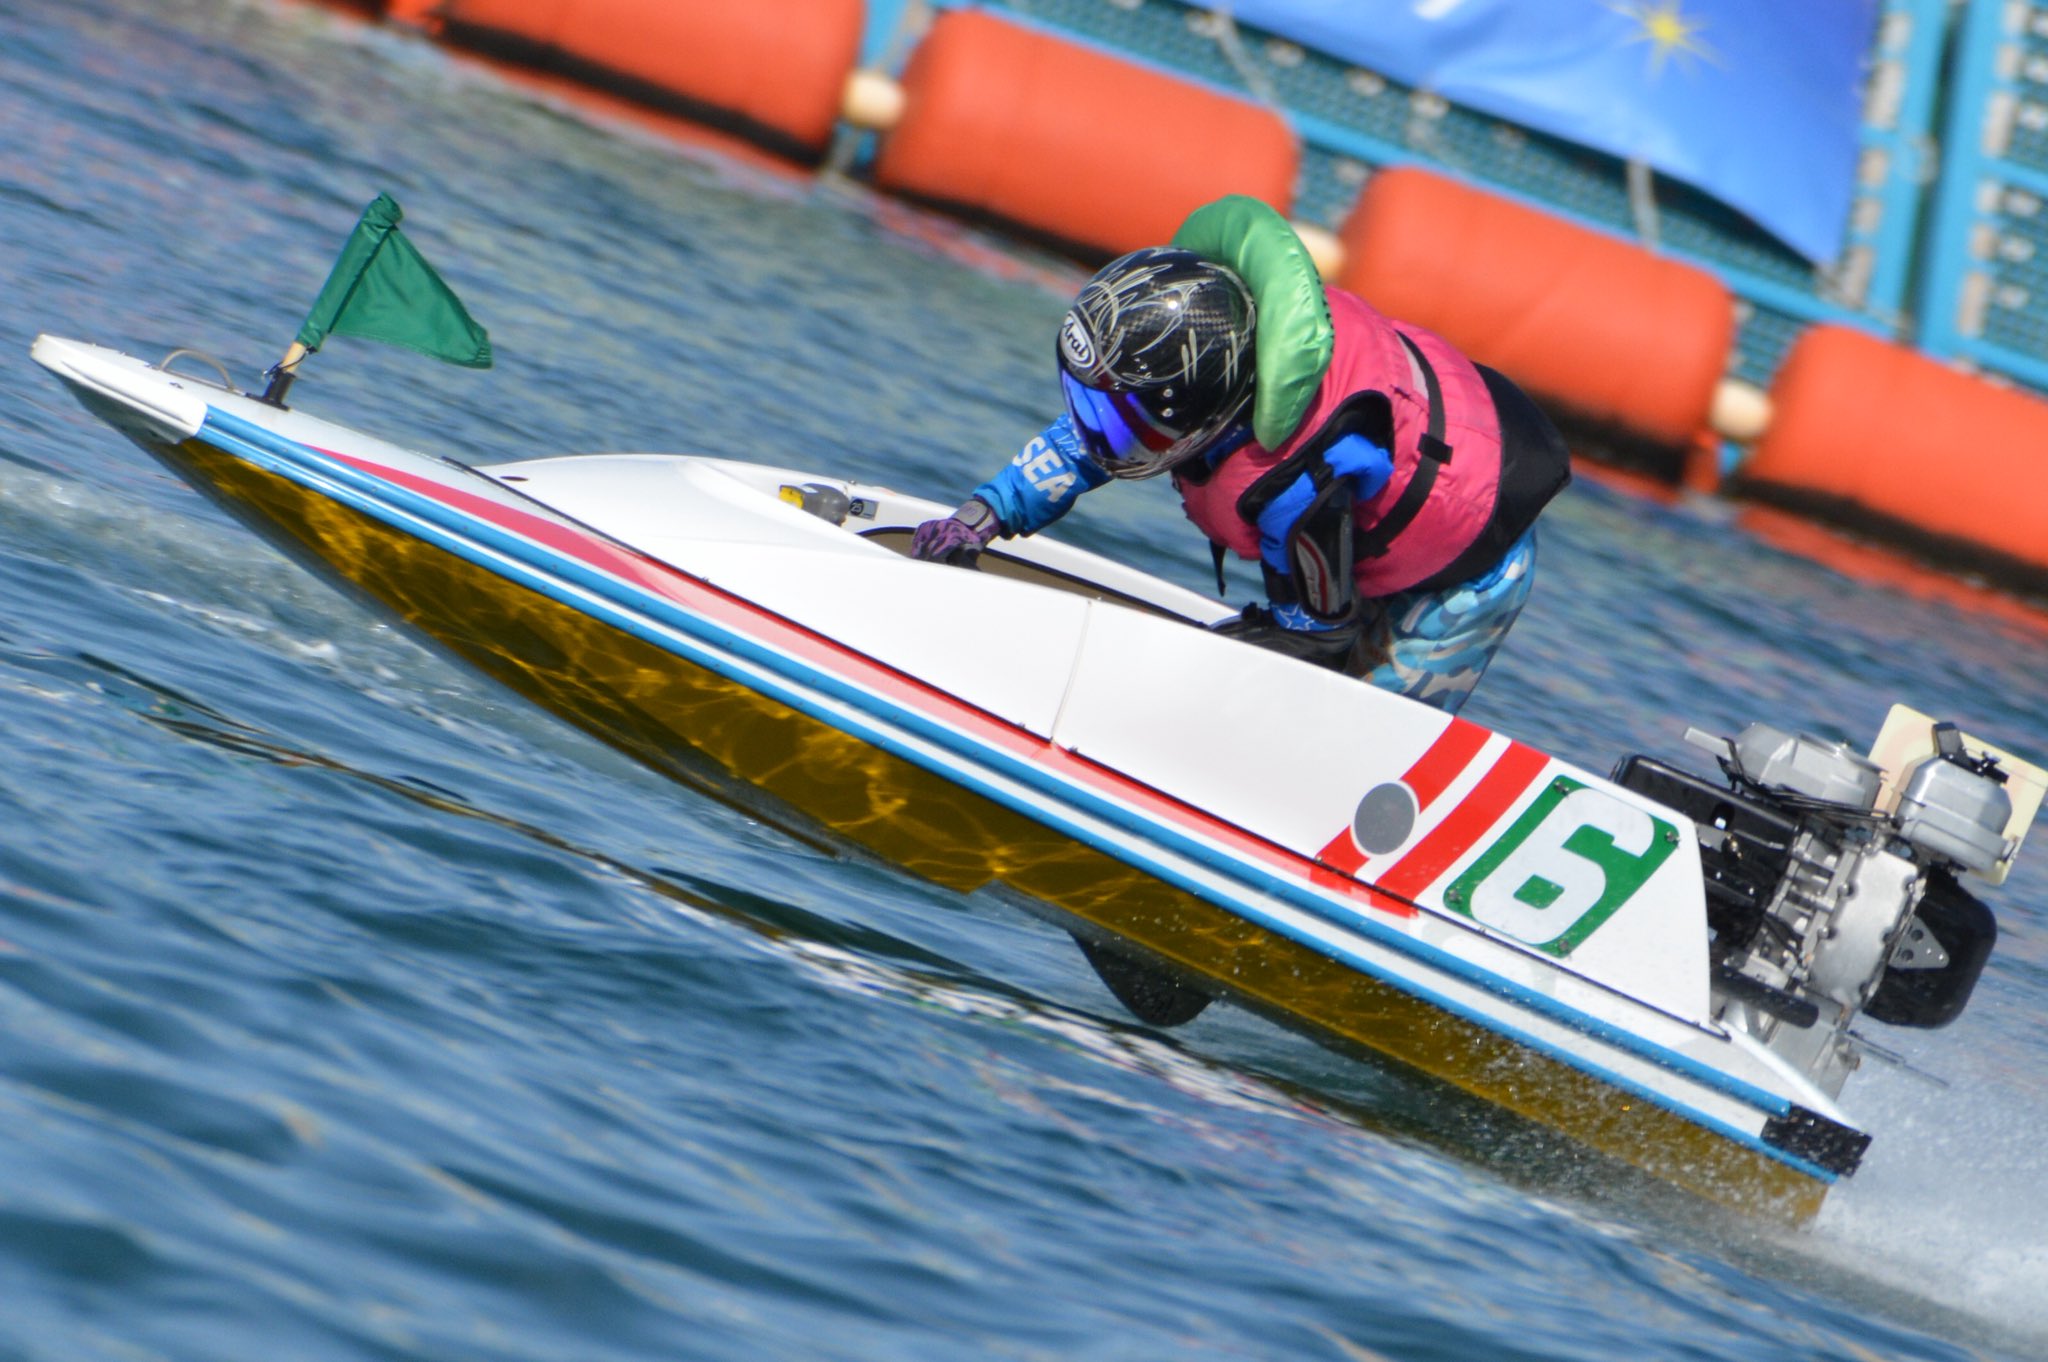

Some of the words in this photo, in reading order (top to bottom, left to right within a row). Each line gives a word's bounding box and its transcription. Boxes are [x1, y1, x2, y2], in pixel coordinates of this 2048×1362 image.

[1063, 322, 1089, 357] Arai
[1012, 436, 1076, 503] SEA
[1470, 787, 1654, 945] 6
